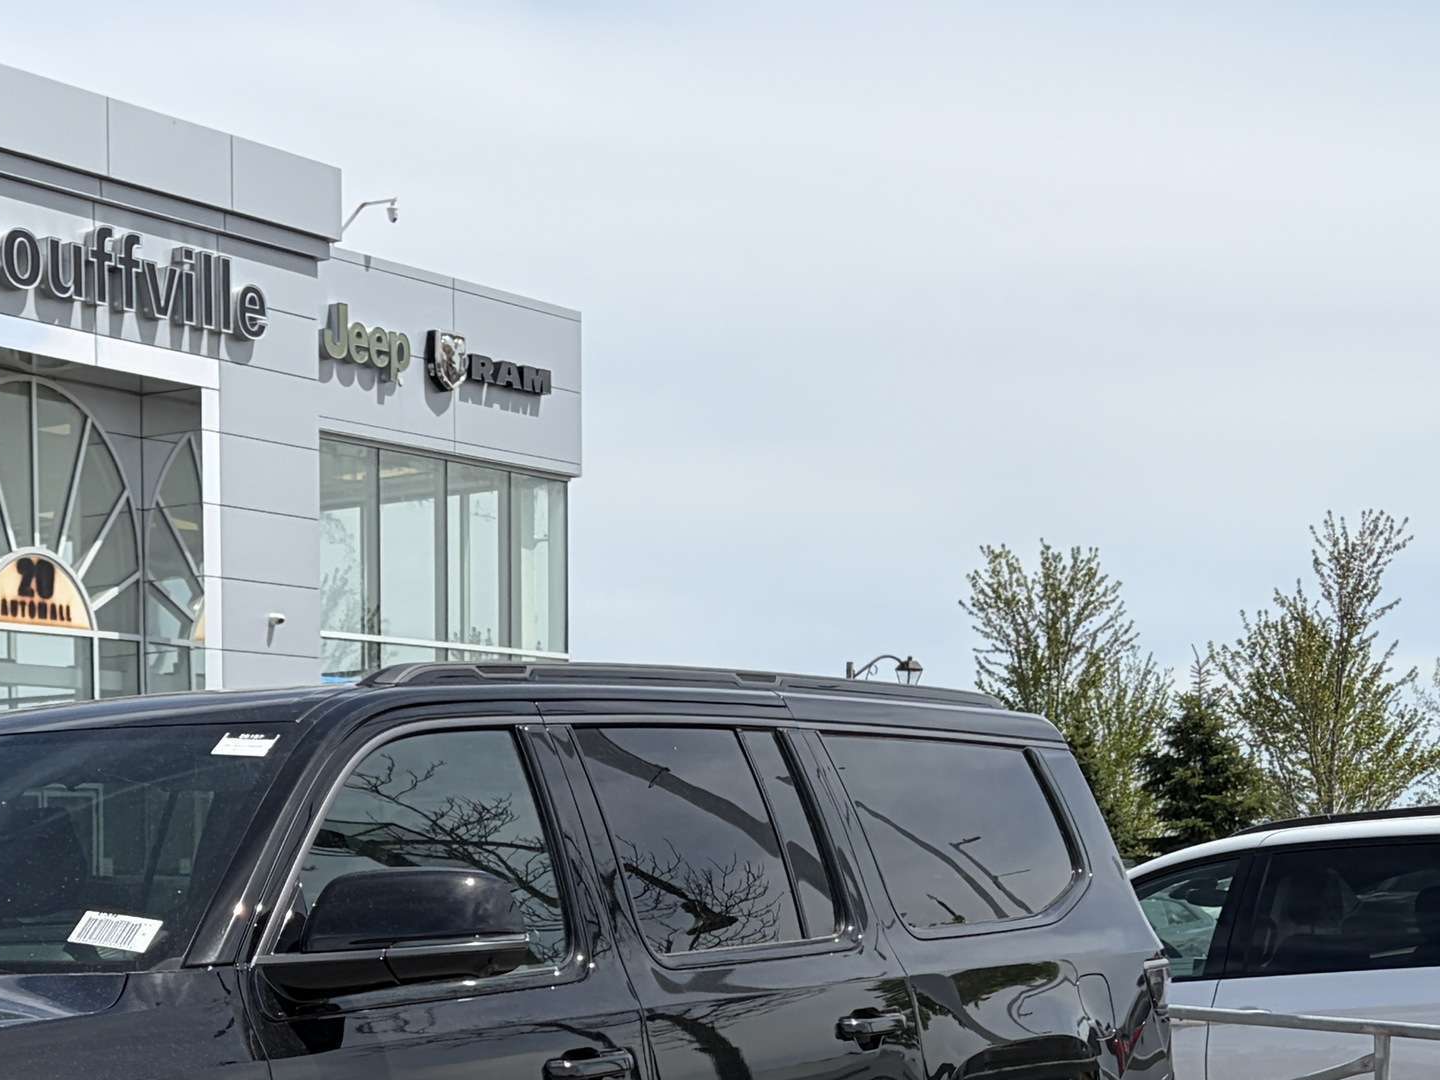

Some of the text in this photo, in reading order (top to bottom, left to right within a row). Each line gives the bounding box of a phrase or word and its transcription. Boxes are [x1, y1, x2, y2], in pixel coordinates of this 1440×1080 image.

[320, 302, 411, 384] Jeep
[469, 353, 552, 395] RAM
[16, 557, 56, 599] 20
